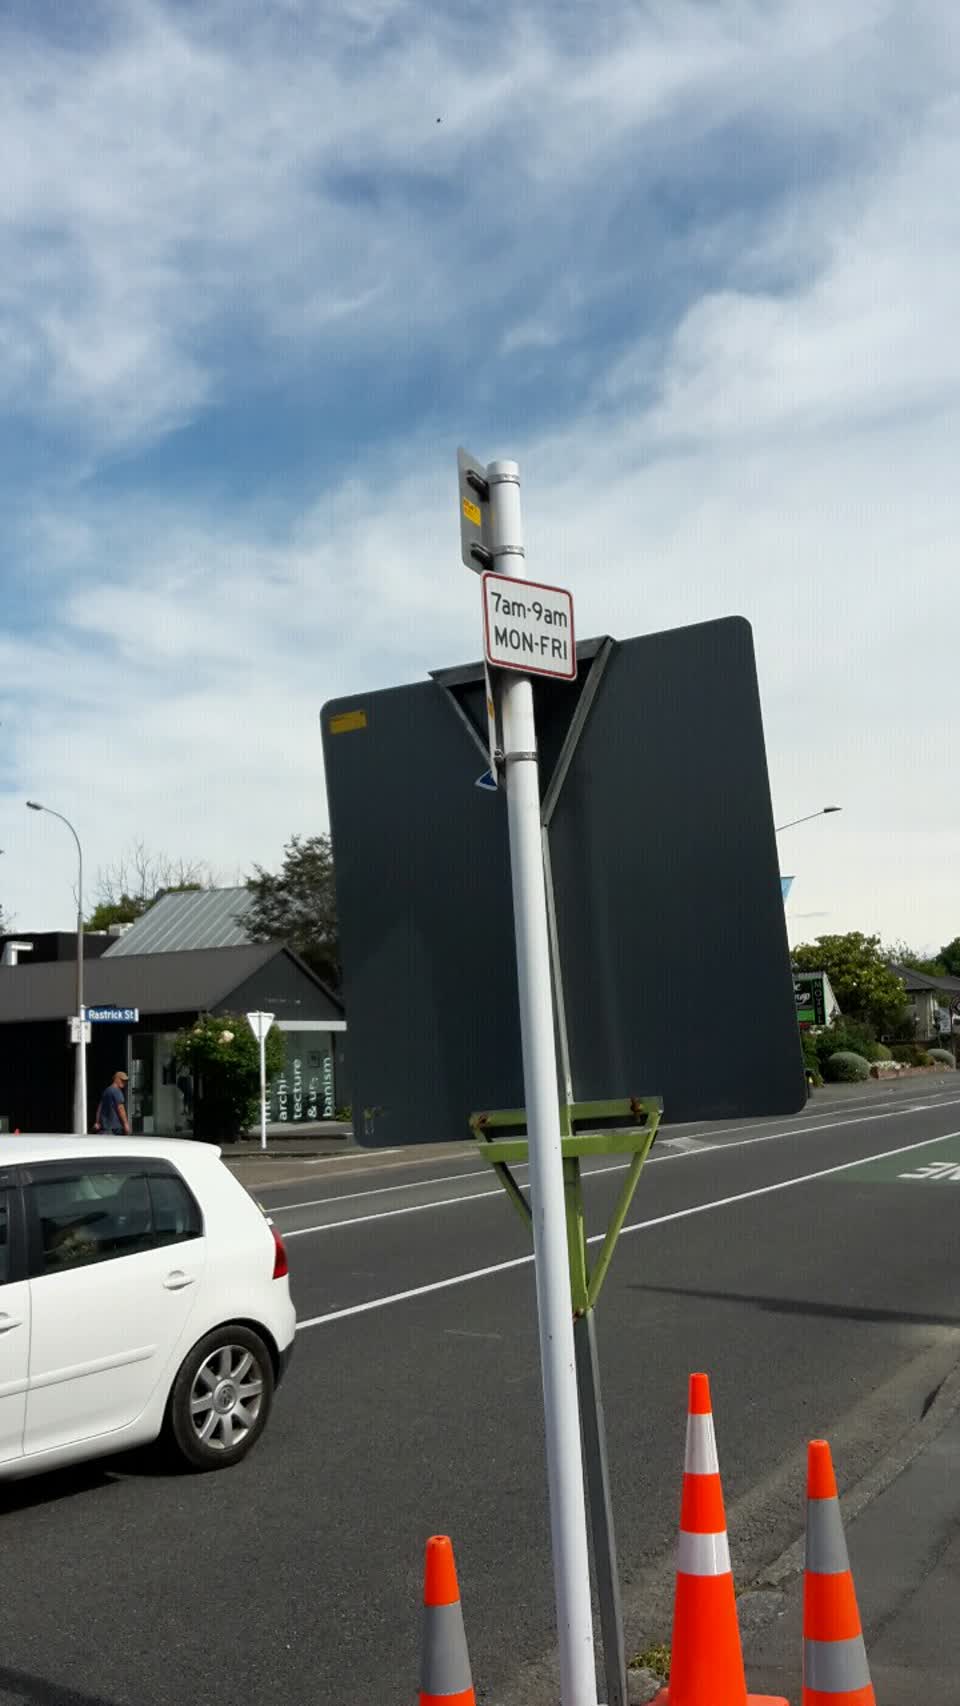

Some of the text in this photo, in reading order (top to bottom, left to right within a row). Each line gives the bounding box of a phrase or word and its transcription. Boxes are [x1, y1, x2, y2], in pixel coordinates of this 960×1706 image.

[494, 625, 567, 660] MON-FRI
[88, 1009, 134, 1020] Rastrick St
[293, 1058, 302, 1120] tecture
[322, 1056, 333, 1118] banism
